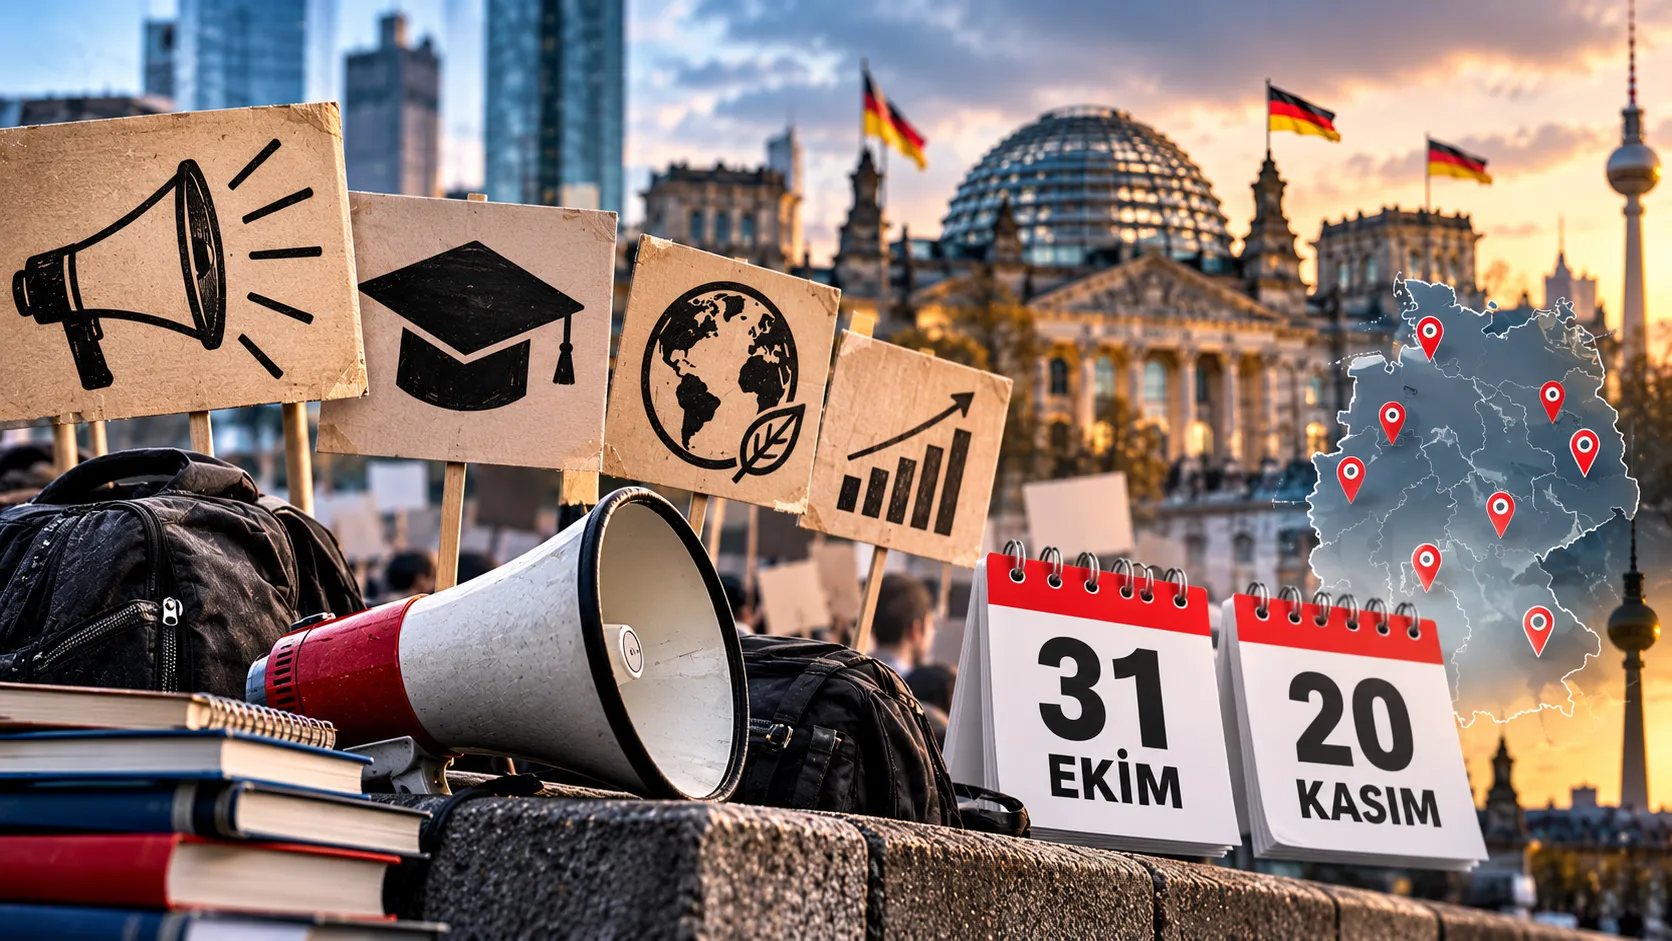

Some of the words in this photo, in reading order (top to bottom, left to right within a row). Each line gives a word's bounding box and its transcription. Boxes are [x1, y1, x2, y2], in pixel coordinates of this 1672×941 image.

[1038, 636, 1168, 750] 31
[1289, 671, 1414, 772] 20
[1049, 748, 1183, 809] EKİM
[1296, 779, 1442, 828] KASIM
